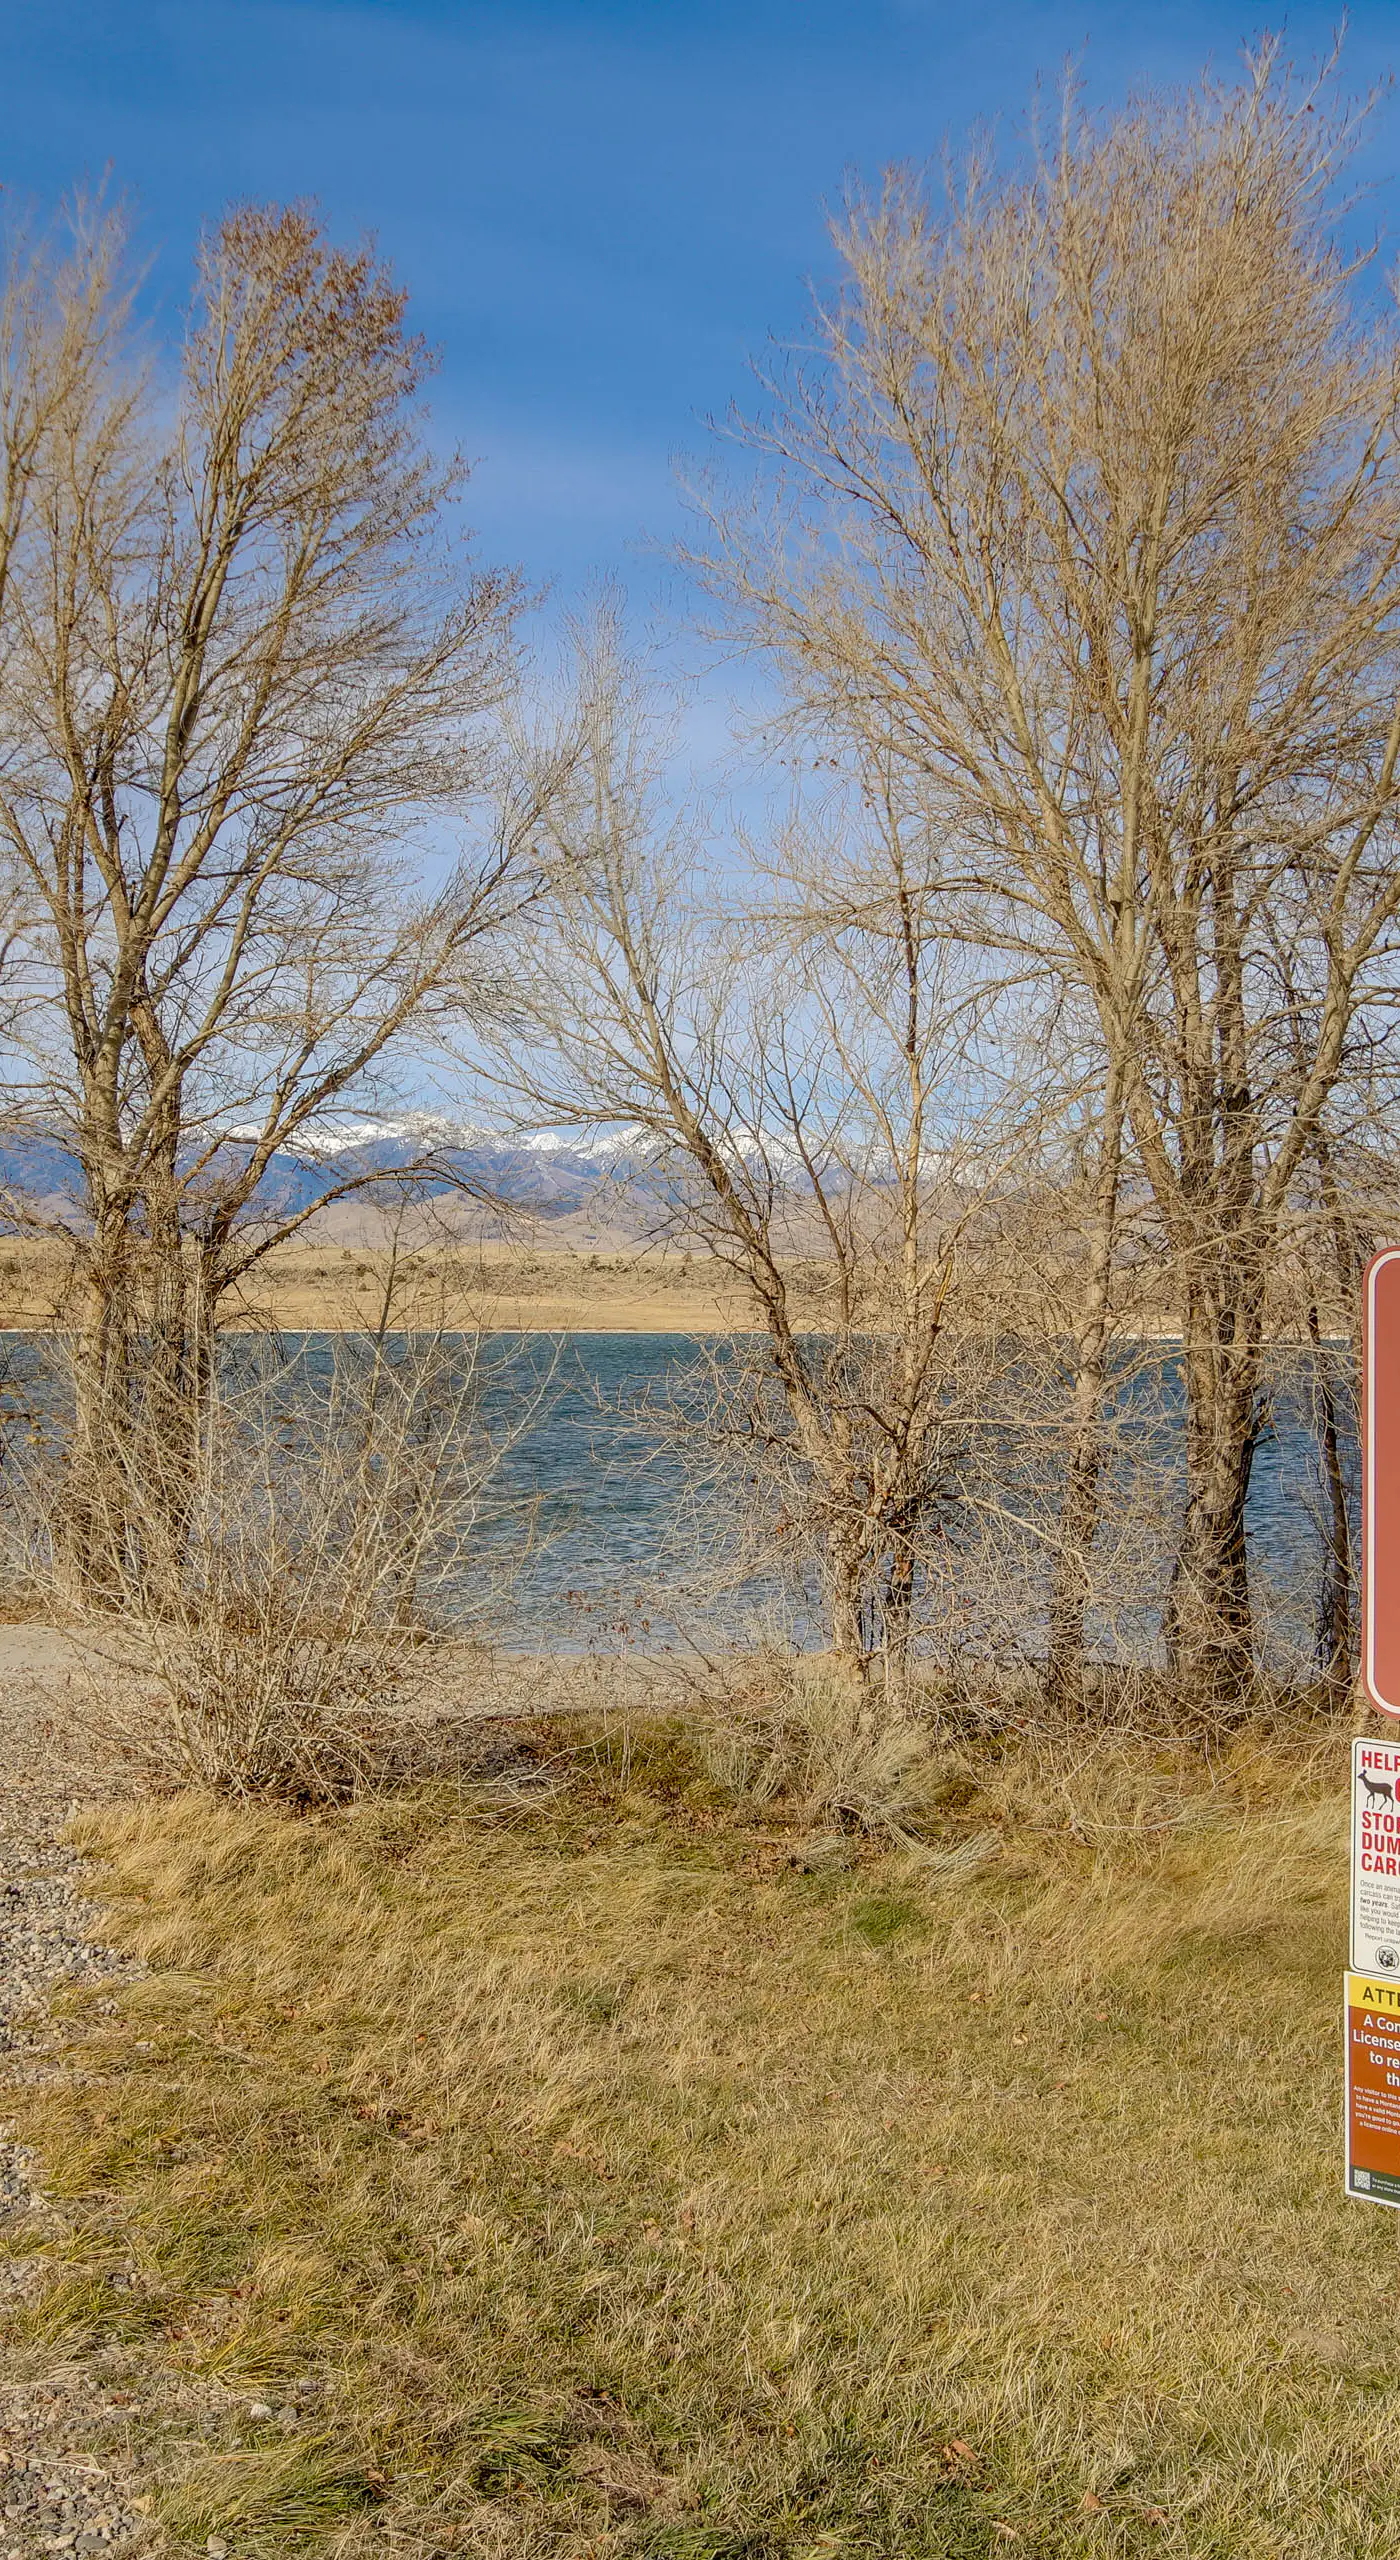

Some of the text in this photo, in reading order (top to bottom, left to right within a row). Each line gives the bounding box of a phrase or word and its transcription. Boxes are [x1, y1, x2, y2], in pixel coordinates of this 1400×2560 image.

[1361, 1853, 1400, 1876] CAR
[1360, 1897, 1370, 1905] two
[1363, 2014, 1374, 2028] A
[1353, 2028, 1400, 2051] License
[1369, 2050, 1400, 2069] to re
[1386, 2071, 1400, 2087] th
